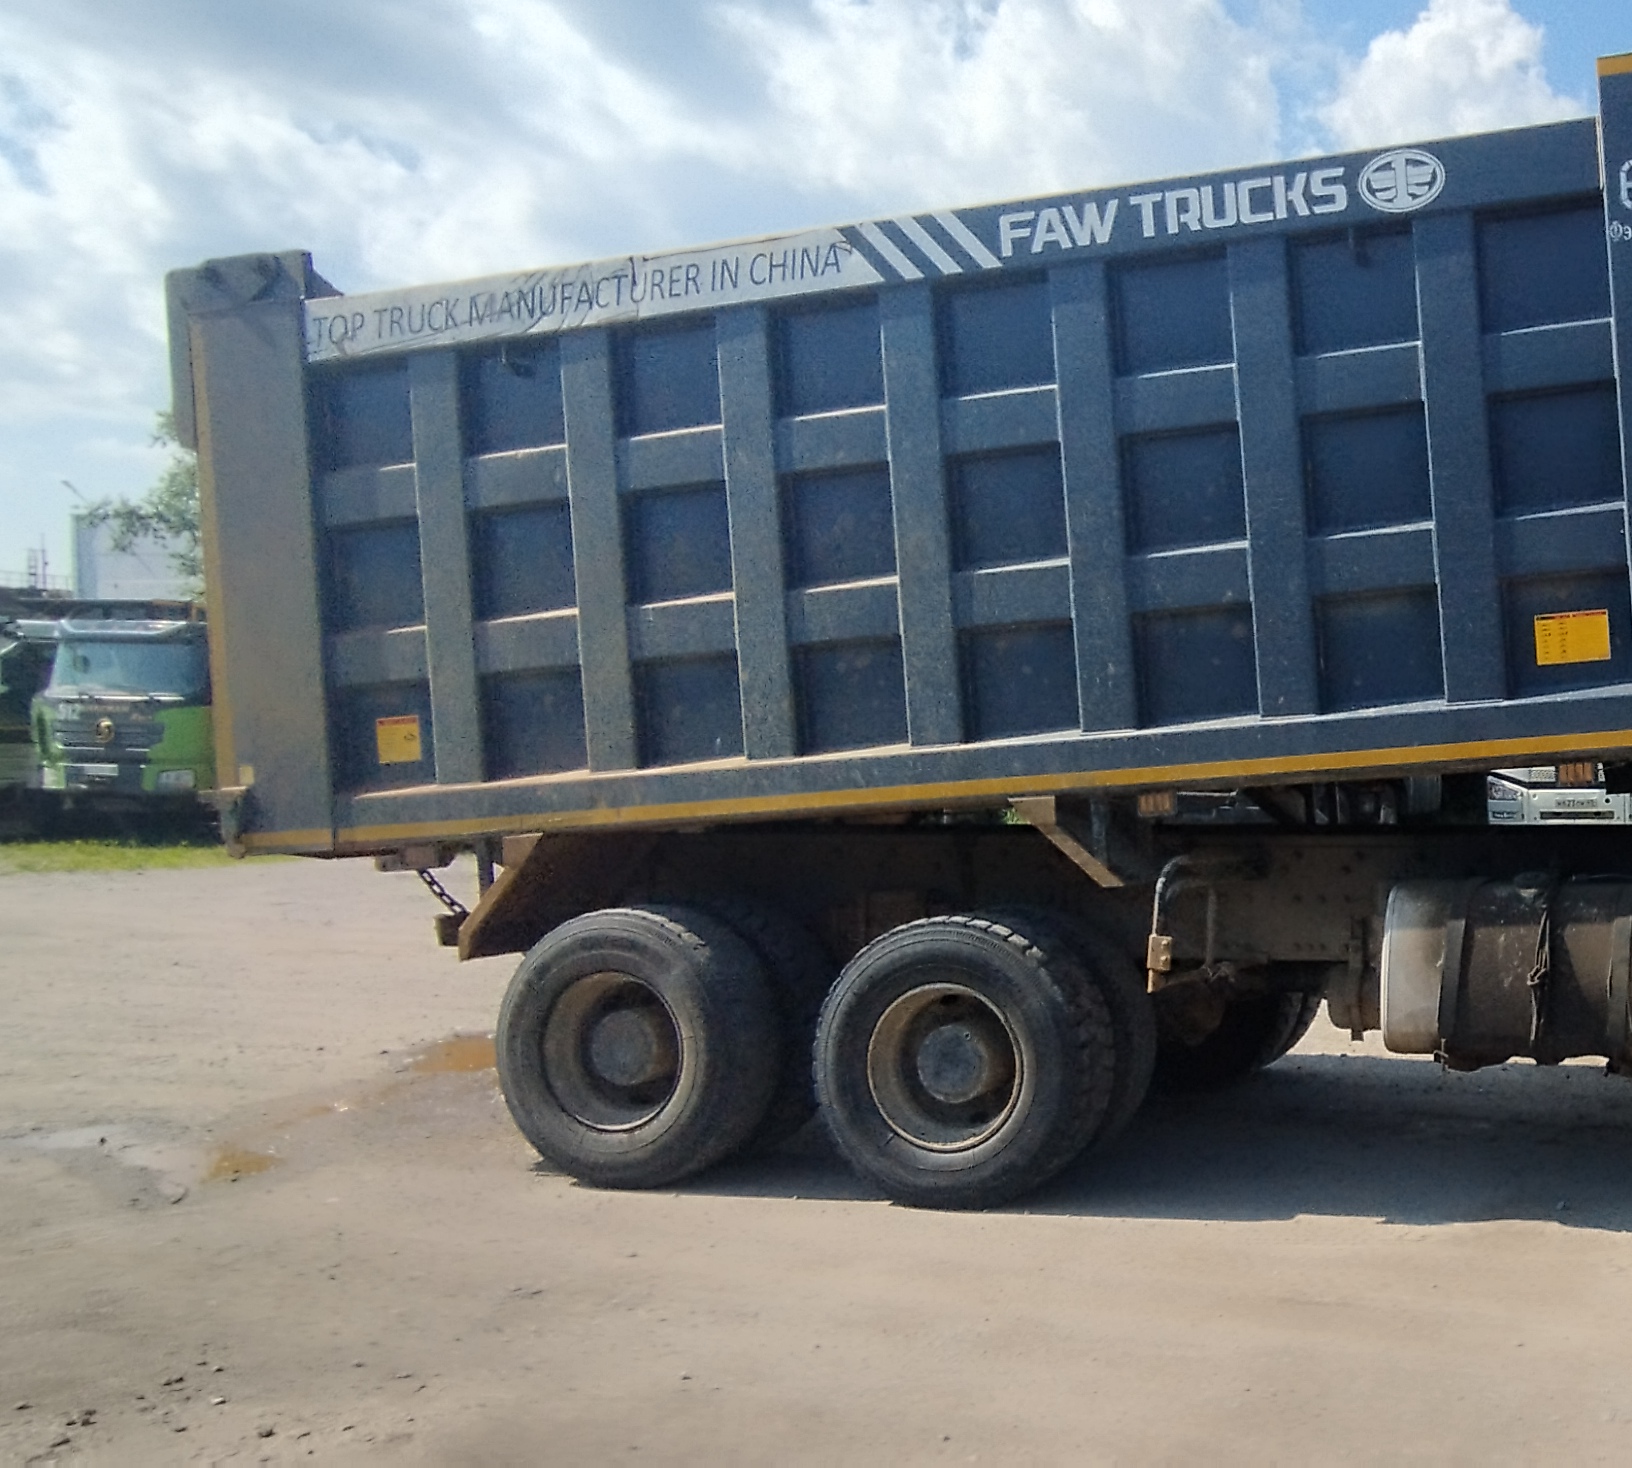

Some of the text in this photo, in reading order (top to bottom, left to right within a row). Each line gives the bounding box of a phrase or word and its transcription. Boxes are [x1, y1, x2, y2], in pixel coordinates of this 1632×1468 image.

[999, 166, 1347, 257] FAW TRUCKS
[313, 244, 842, 347] TOP TRUCK MANUFACTURER IN CHINA
